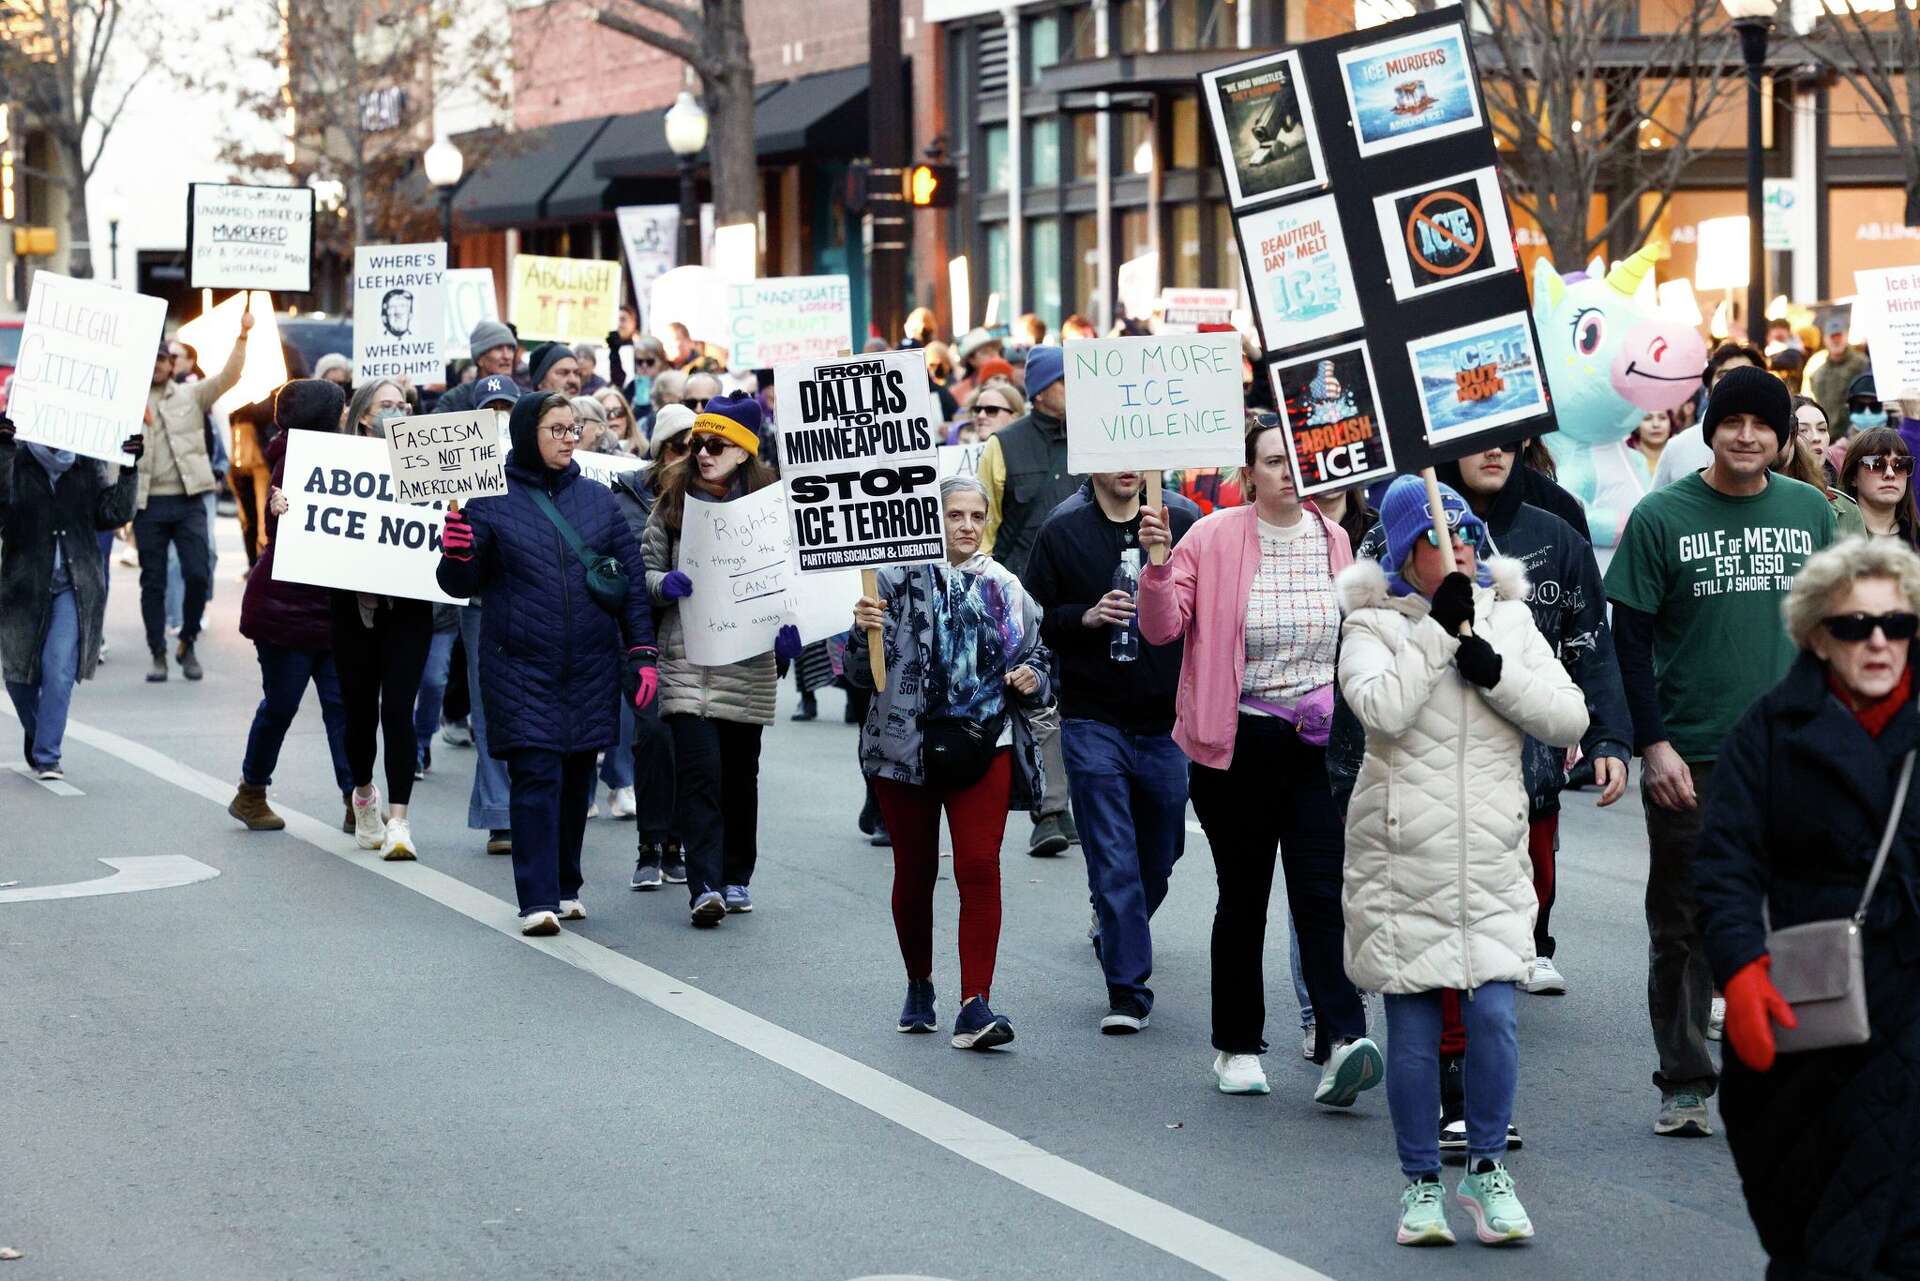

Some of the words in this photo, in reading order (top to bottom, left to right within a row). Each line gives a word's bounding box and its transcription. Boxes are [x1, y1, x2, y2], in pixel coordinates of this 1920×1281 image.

[1362, 63, 1385, 82] ICE
[1386, 48, 1446, 78] MURDERS
[213, 224, 287, 242] MURDERED
[1261, 220, 1325, 256] BEAUTIFUL
[1416, 207, 1475, 256] ICE
[369, 254, 436, 269] WHERE'S
[1264, 251, 1286, 273] DAY
[1296, 235, 1328, 260] MELT
[525, 263, 610, 293] ABOLISH
[1270, 262, 1342, 312] ICE
[1885, 275, 1908, 292] Ice
[31, 279, 123, 349] ILLEGAL
[19, 332, 120, 401] CITIZEN
[362, 362, 401, 378] NEED
[404, 360, 440, 375] HIM?
[1076, 350, 1123, 380] NO
[1142, 345, 1232, 375] MORE
[1451, 340, 1496, 370] ICE
[817, 362, 882, 381] FROM
[1456, 363, 1498, 386] OUT
[799, 370, 907, 424] DALLAS
[1118, 379, 1189, 406] ICE
[1457, 378, 1504, 403] NOW!
[391, 421, 484, 450] FASCISM
[840, 413, 873, 428] TO
[1101, 410, 1232, 442] VIOLENCE
[1300, 415, 1373, 454] ABOLISH
[400, 455, 430, 469] IS
[438, 447, 465, 466] NOT
[470, 443, 497, 462] THE
[785, 417, 931, 465] MINNEAPOLIS
[1315, 441, 1369, 482] ICE
[400, 476, 473, 499] AMERICAN
[475, 463, 505, 491] WAY!
[791, 465, 937, 504] STOP
[304, 504, 367, 540] ICE
[795, 505, 838, 547] ICE
[839, 496, 941, 543] TERROR
[712, 553, 746, 571] things
[758, 543, 775, 553] the
[802, 553, 828, 567] PARTY
[828, 551, 843, 564] FOR
[844, 547, 886, 563] SOCIALISM
[886, 545, 897, 559] &
[897, 541, 941, 558] LIBERATION
[1679, 530, 1725, 562] GULF
[1728, 538, 1742, 554] OF
[1744, 527, 1812, 556] MEXICO
[1715, 555, 1744, 577] EST.
[1750, 553, 1784, 575] 1550
[732, 573, 784, 597] CAN'T
[1693, 579, 1723, 597] STILL
[1726, 577, 1733, 593] A
[1735, 575, 1770, 592] SHORE
[708, 617, 738, 633] take
[752, 613, 781, 626] away
